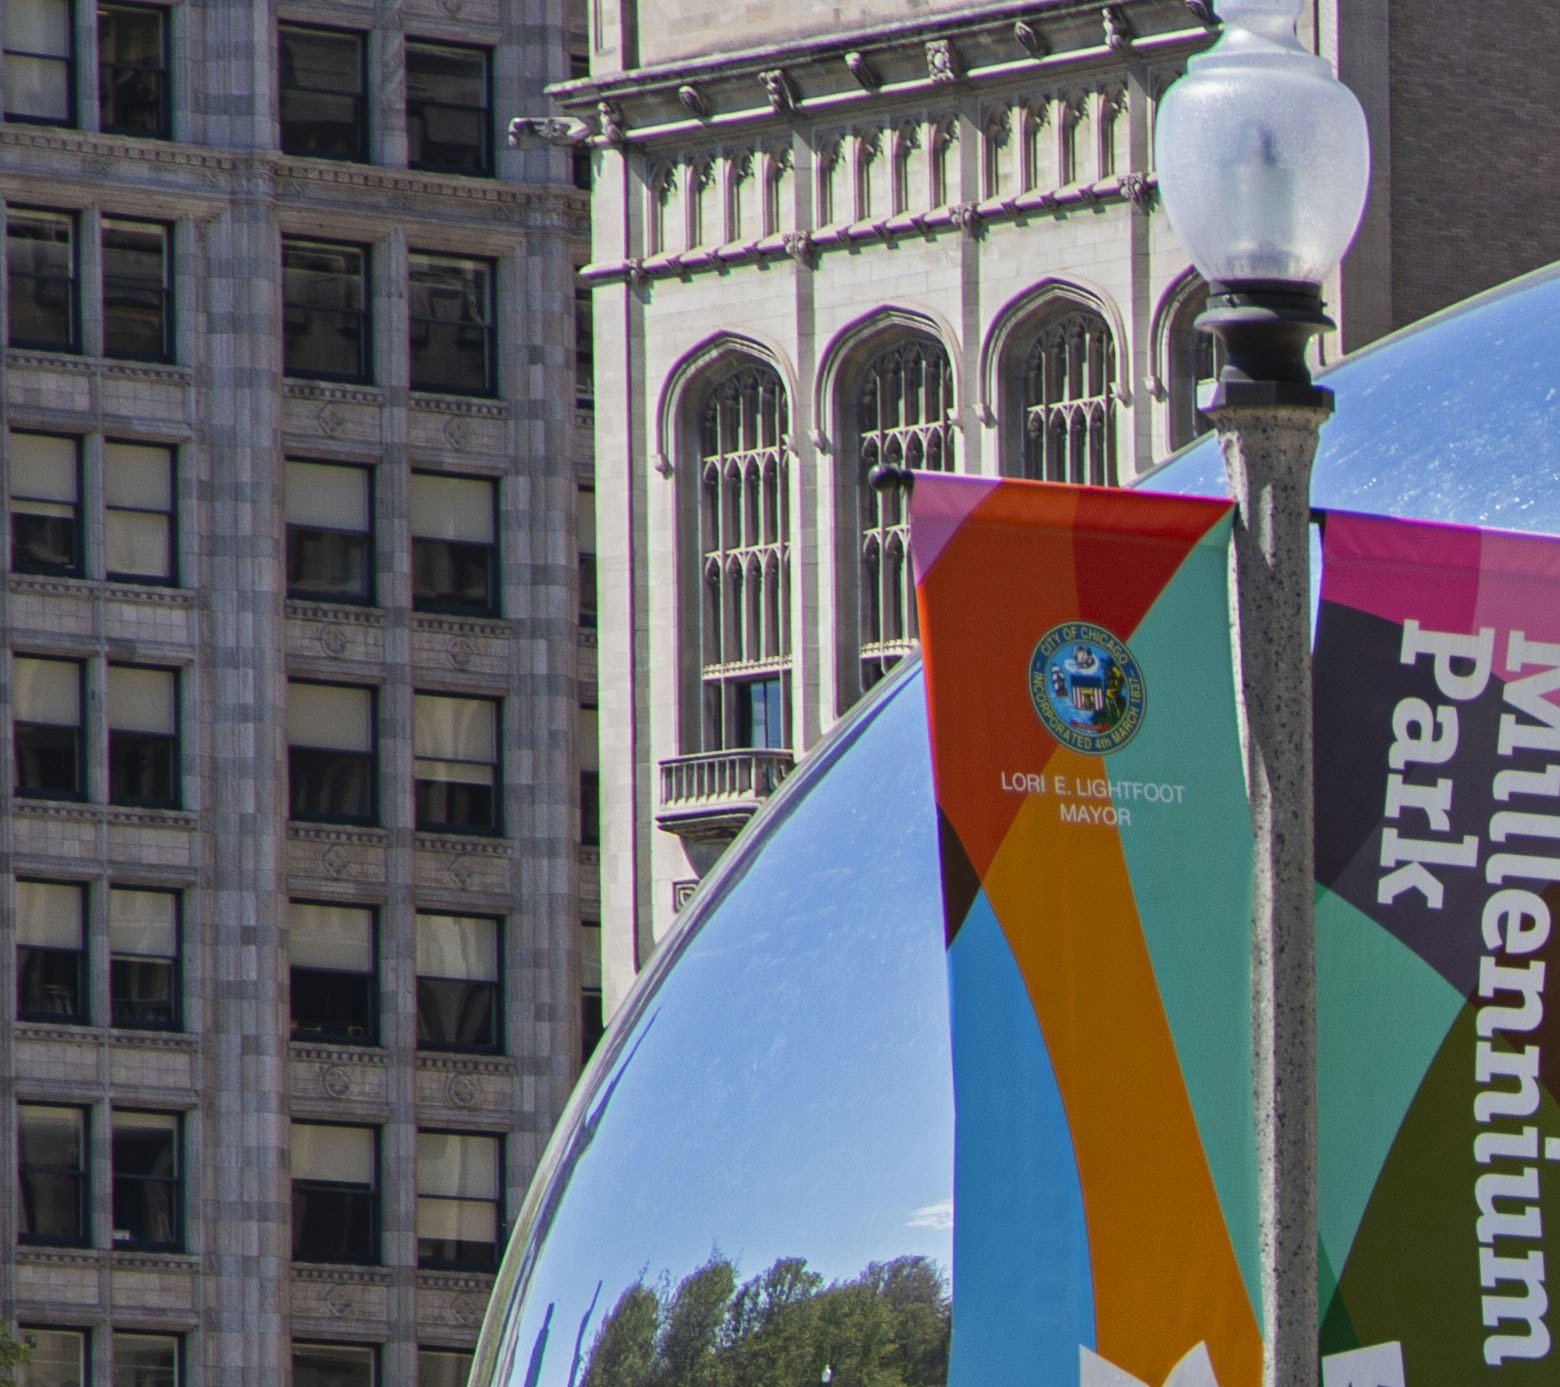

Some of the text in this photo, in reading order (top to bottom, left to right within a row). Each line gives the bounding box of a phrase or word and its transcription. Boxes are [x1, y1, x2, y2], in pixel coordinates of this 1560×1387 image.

[1040, 627, 1129, 665] CITY OF CHICAGO
[1032, 671, 1092, 749] INCORPORATED
[1112, 708, 1140, 742] MARCH
[1129, 678, 1141, 704] 1837
[1376, 618, 1495, 909] Park
[1000, 772, 1186, 804] LORI E. LIGHTFOOT
[1059, 804, 1132, 826] MAYOR
